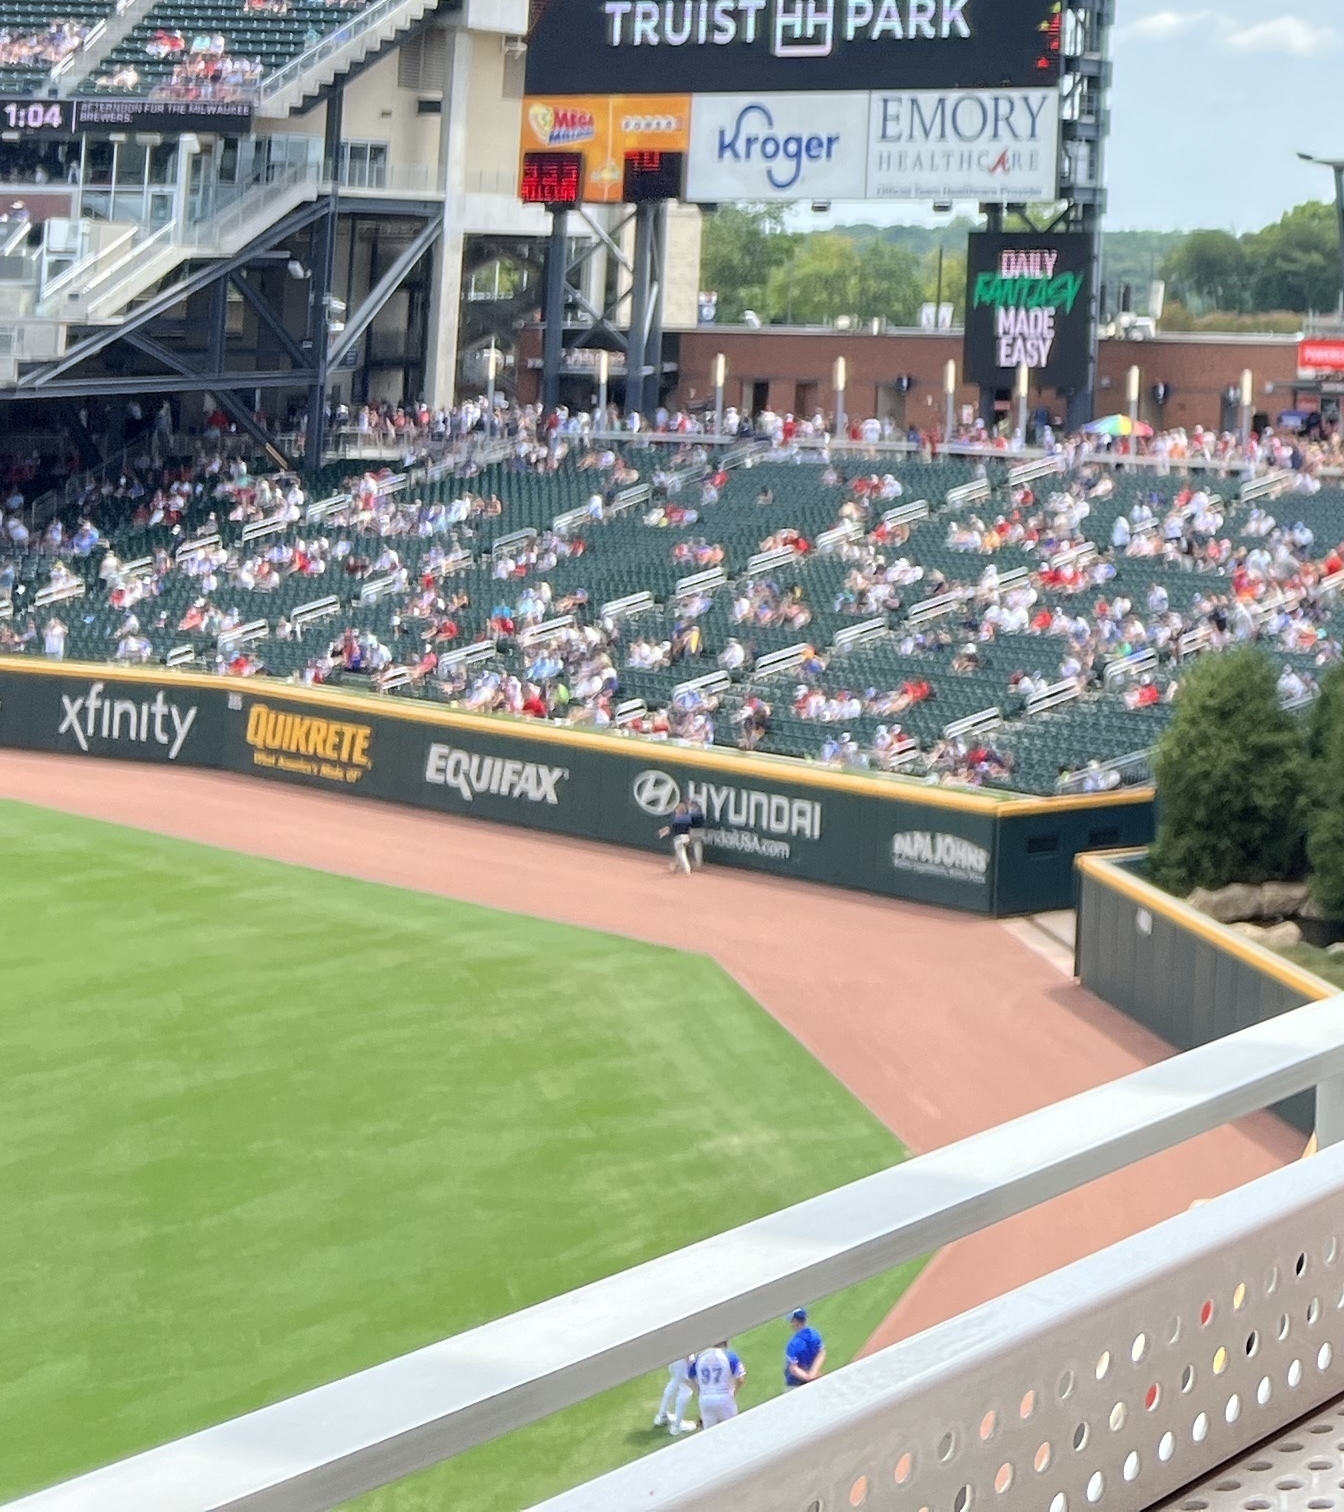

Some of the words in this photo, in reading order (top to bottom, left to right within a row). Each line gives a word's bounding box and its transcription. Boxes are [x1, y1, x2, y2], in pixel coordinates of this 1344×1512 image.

[4, 102, 63, 129] 1:04
[167, 103, 186, 115] THE
[878, 95, 1049, 144] EMORY
[717, 103, 841, 190] Kroger
[877, 146, 1040, 175] HEALTHCARE
[1000, 249, 1058, 280] DAILY
[973, 271, 1085, 316] FANTASY
[997, 306, 1056, 338] MADE
[997, 336, 1053, 368] EASY
[58, 681, 198, 760] xfinity
[246, 703, 370, 765] QUIKRETE
[425, 742, 563, 805] EQUIFAX
[687, 780, 822, 841] HYUNDAI
[893, 830, 934, 864] PAPA
